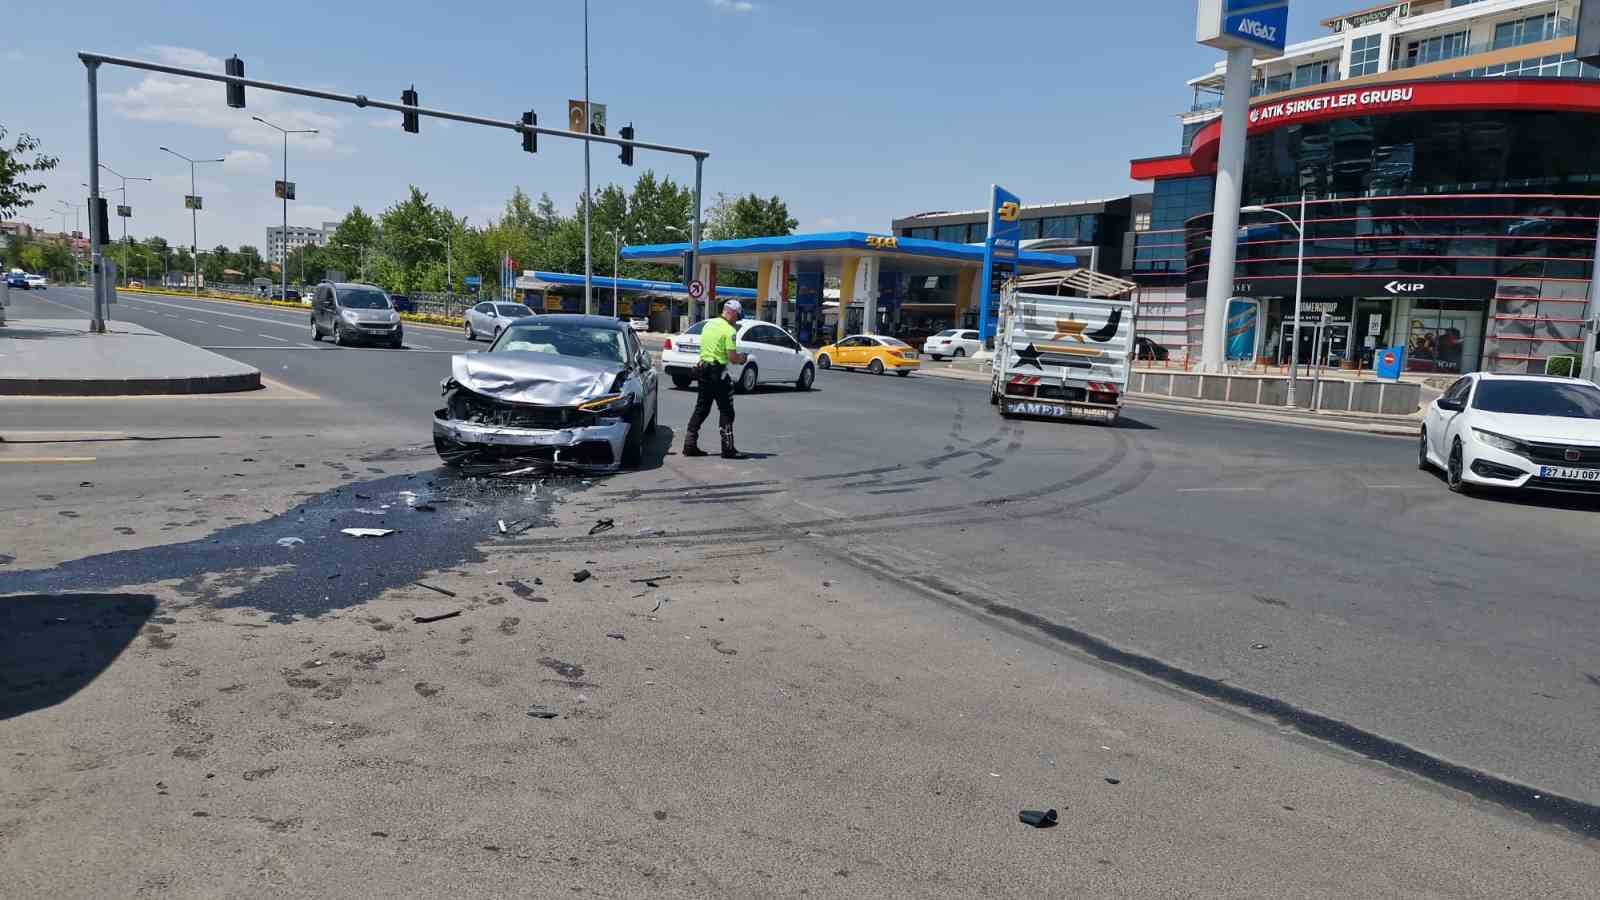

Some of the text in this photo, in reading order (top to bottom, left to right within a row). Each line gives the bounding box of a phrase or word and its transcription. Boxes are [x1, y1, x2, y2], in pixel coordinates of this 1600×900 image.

[1238, 16, 1276, 41] AYGAZ
[1260, 103, 1285, 120] ATIK
[1360, 87, 1413, 104] GRUBU
[1397, 283, 1424, 291] KIP
[1015, 403, 1064, 416] AMED
